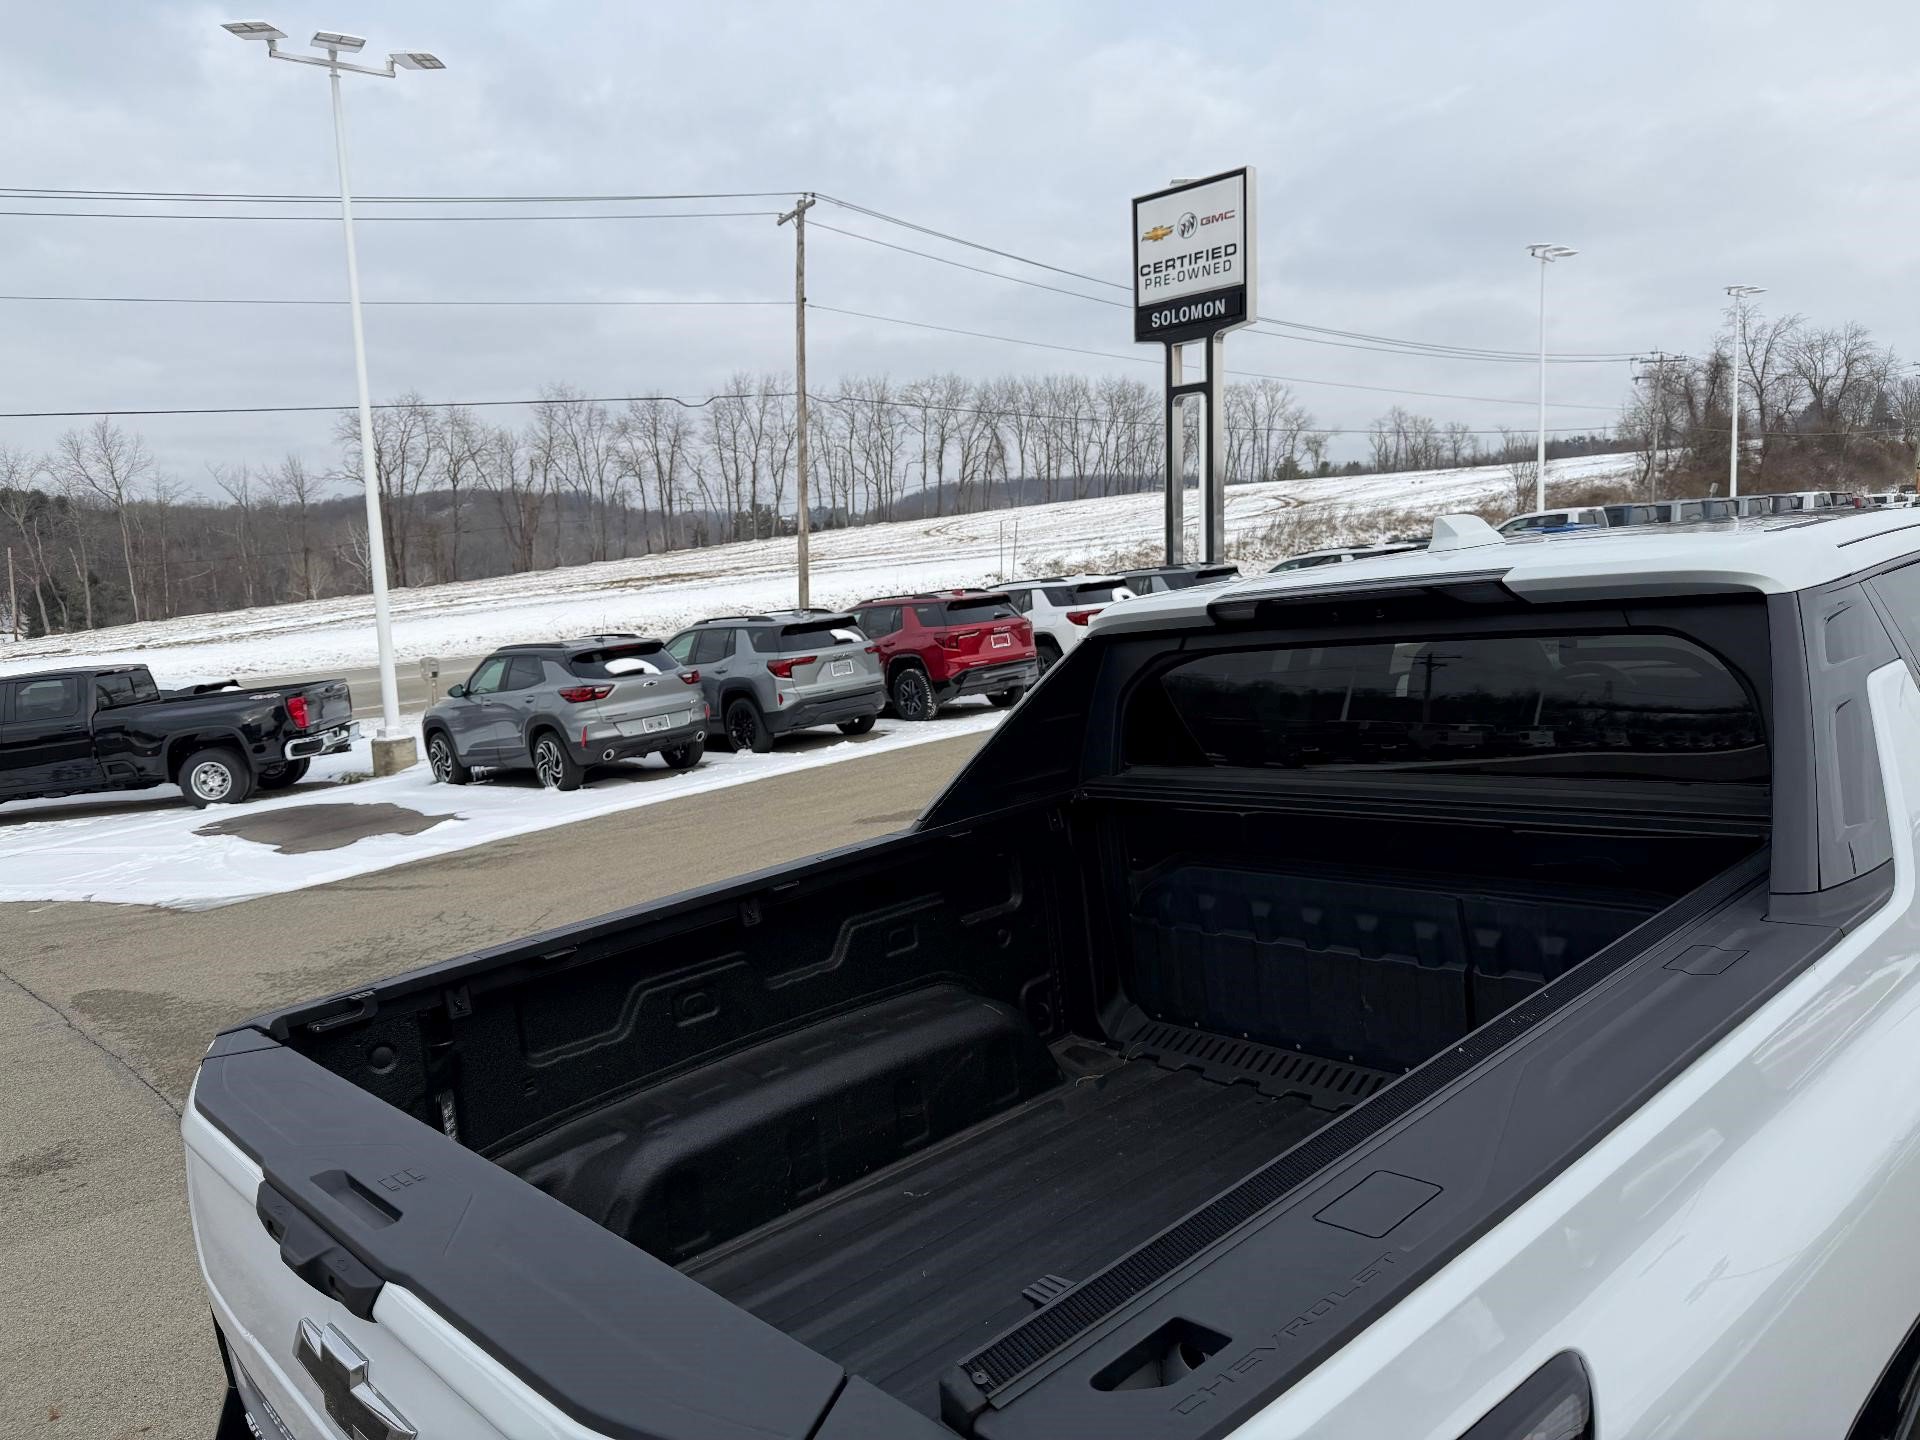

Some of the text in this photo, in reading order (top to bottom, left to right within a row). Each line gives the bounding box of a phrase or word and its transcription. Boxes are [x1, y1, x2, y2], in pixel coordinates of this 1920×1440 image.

[1200, 210, 1235, 227] GMC
[1140, 243, 1237, 277] CERTIFIED
[1145, 259, 1232, 290] PRE-OWNED
[1151, 298, 1226, 328] SOLOMON
[1171, 1250, 1395, 1415] CHEVROLET
